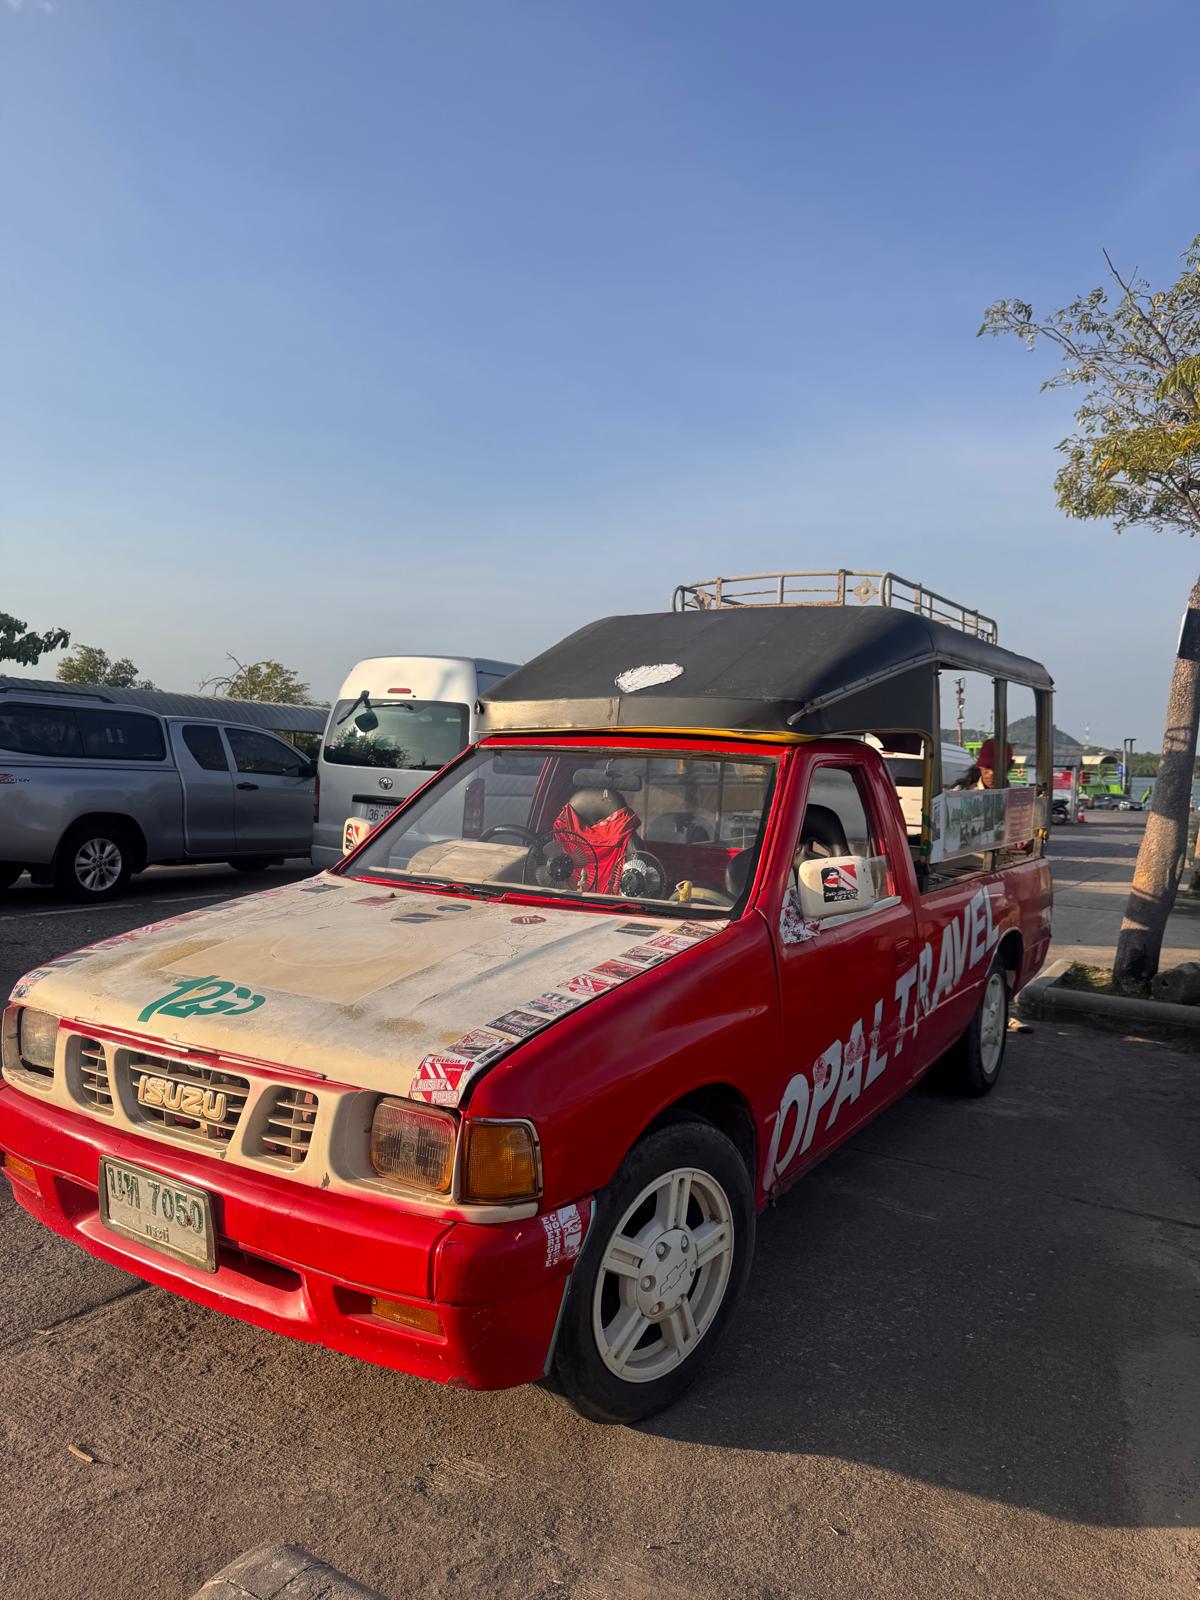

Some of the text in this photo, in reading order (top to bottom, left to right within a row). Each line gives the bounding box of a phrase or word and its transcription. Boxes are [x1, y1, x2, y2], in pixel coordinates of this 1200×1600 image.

[894, 884, 1000, 1058] TRAVEL
[431, 1056, 463, 1064] ENERGIE
[137, 1074, 228, 1123] ISUZU
[762, 998, 888, 1192] OPAL
[148, 1179, 203, 1233] 7050
